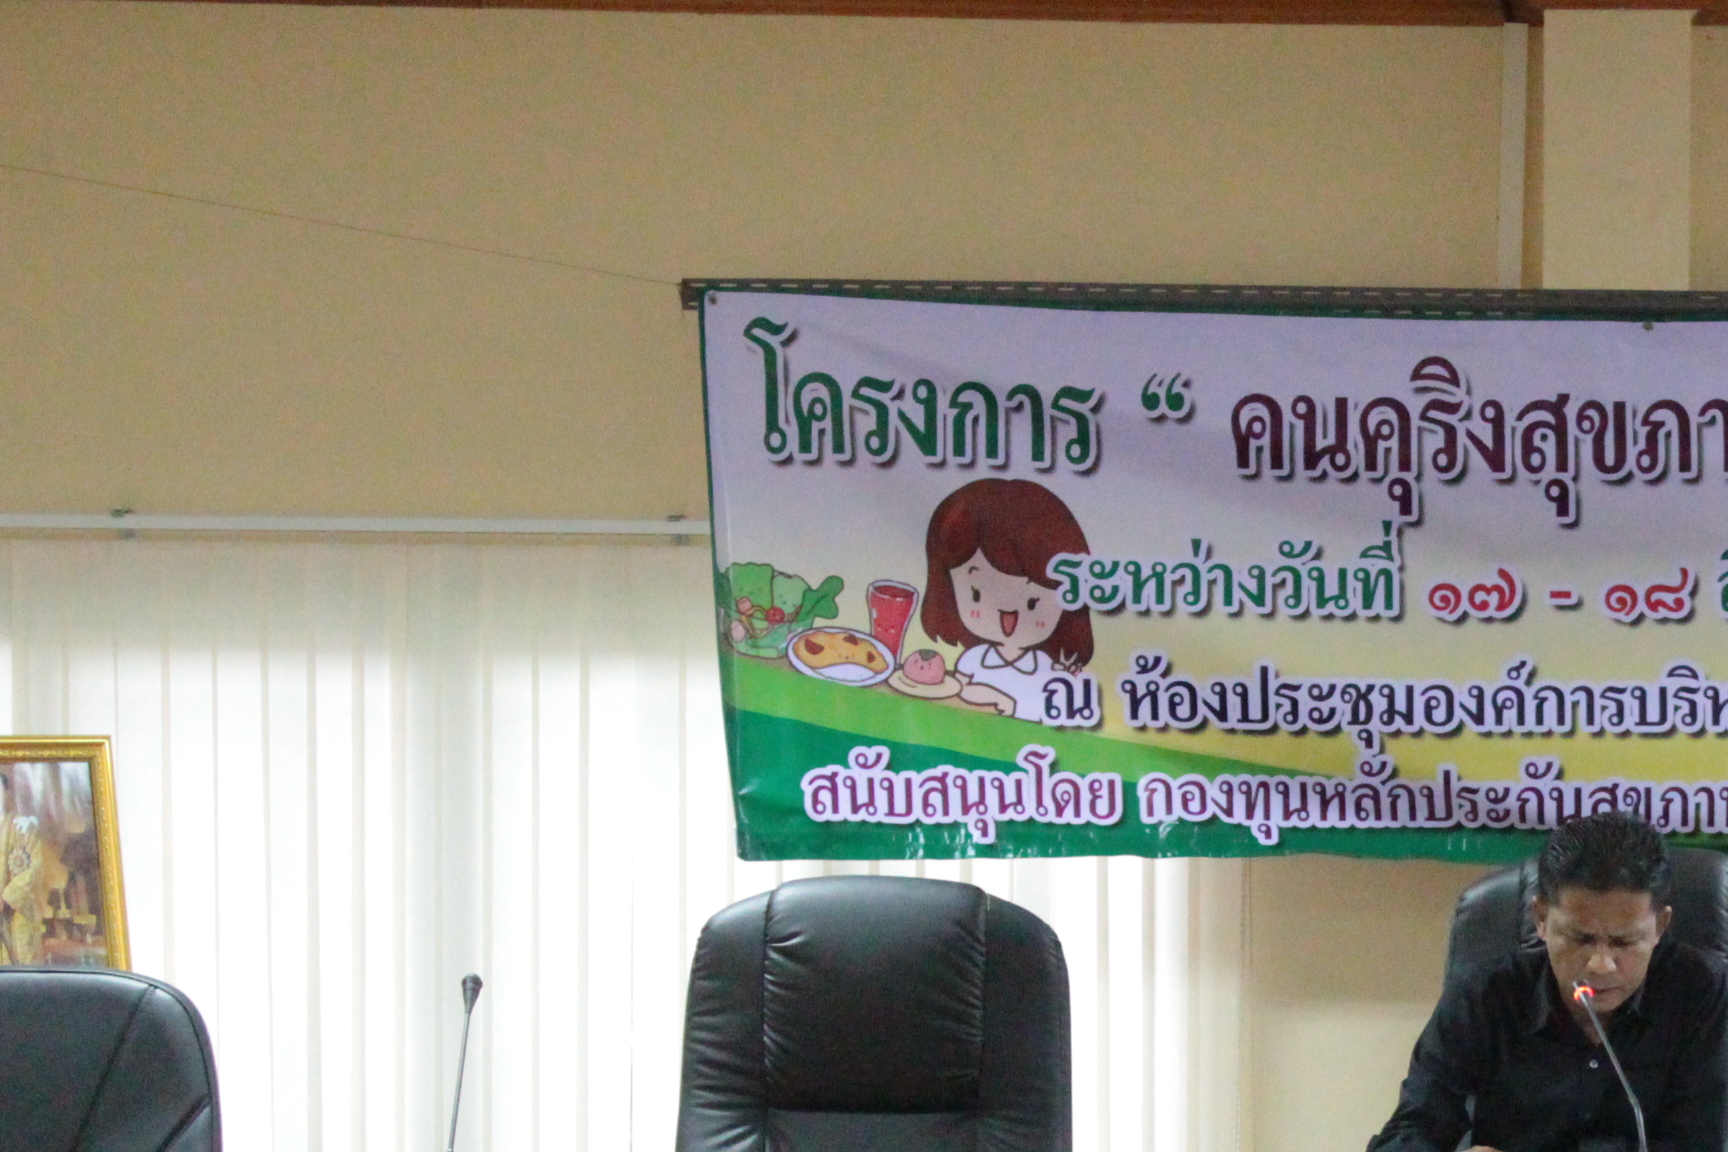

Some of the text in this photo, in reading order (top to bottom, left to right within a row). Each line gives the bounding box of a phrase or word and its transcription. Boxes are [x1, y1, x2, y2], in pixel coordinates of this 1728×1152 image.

[742, 317, 1101, 466] โครงการ
[1052, 521, 1397, 613] ระหว่างวันที่
[1427, 567, 1517, 616] ๑๗
[1605, 566, 1688, 617] ๑๘
[1043, 677, 1098, 722] ณ
[808, 752, 1119, 838] สนับสนุนโดย
